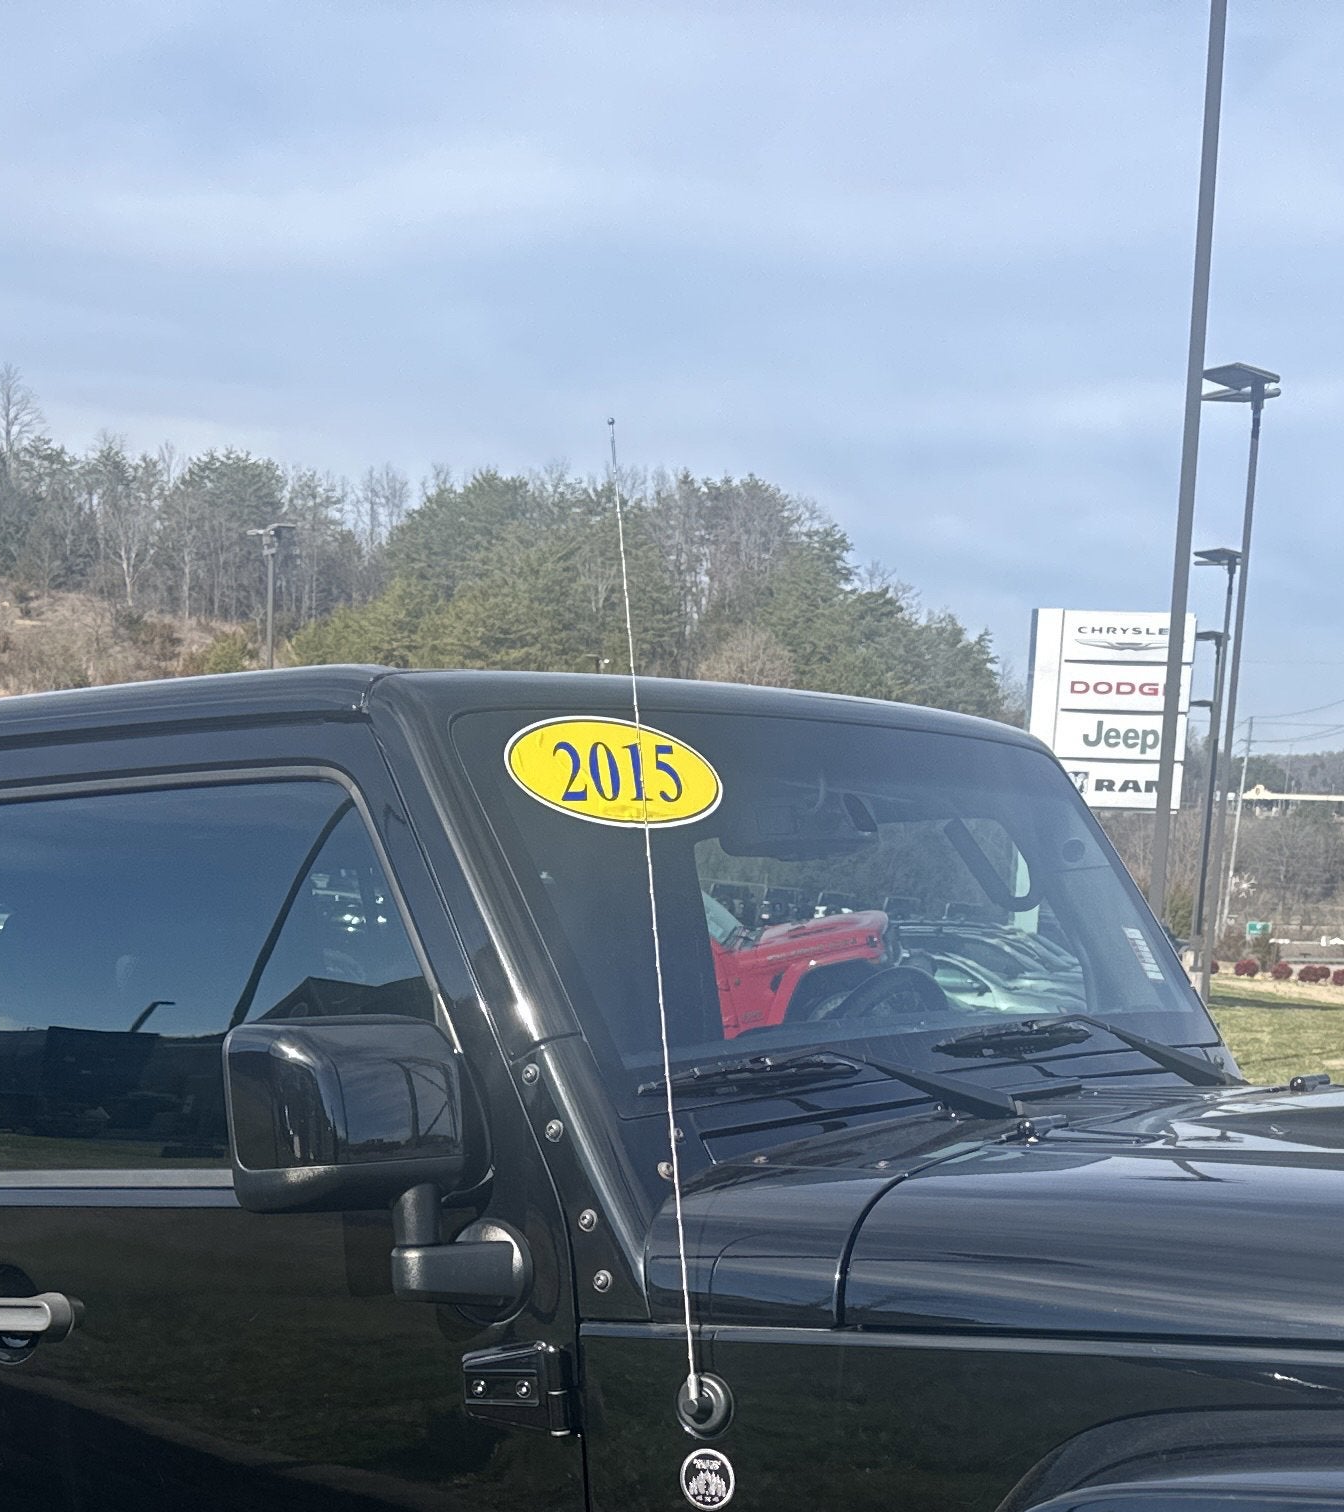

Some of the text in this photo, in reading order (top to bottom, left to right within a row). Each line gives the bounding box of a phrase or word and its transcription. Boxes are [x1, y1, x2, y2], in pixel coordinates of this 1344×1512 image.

[1077, 626, 1169, 636] CHRYSLE
[1070, 680, 1167, 697] DODG
[1082, 720, 1160, 755] Jeep
[552, 741, 683, 803] 2015
